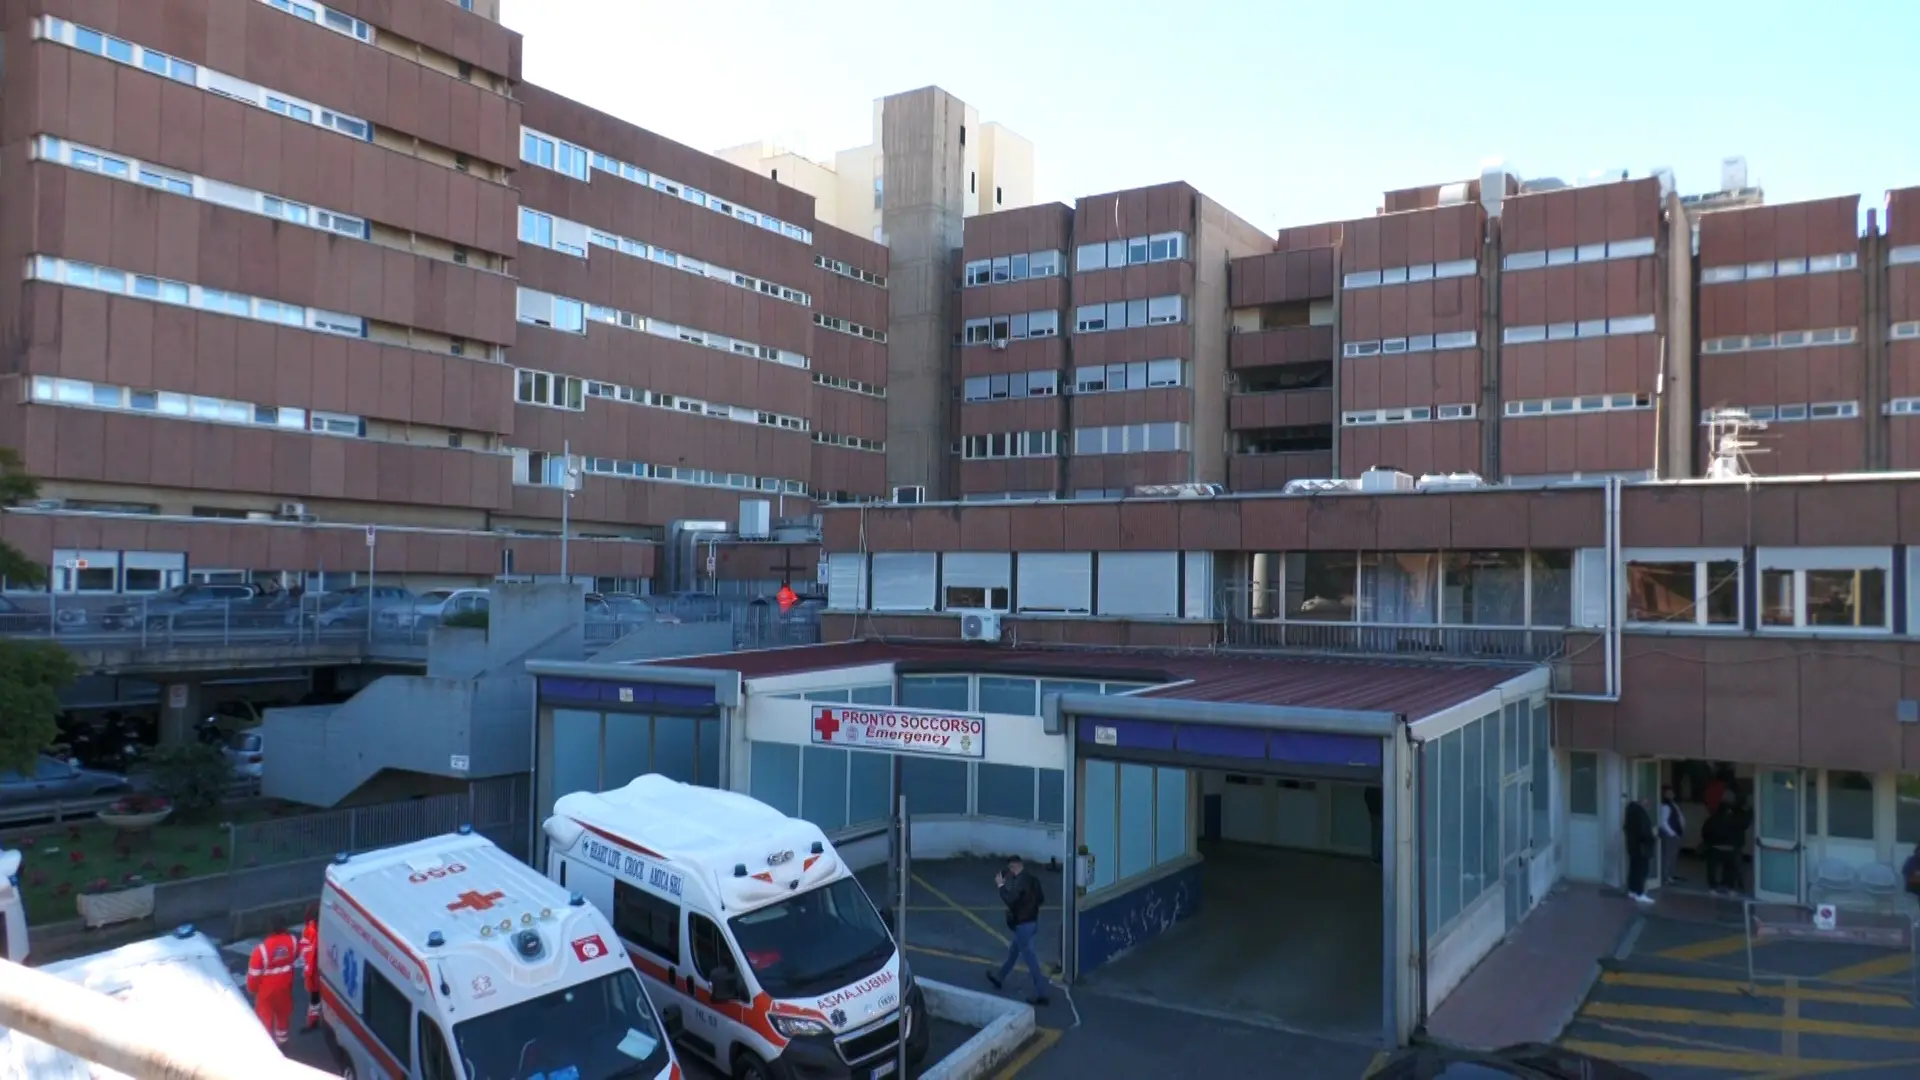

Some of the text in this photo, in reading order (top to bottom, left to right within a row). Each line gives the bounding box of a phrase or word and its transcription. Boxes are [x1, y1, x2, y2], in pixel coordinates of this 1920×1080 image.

[841, 710, 981, 734] PRONTO SOCCORSO
[865, 725, 950, 746] Emergency
[624, 855, 645, 880] CROCE
[648, 866, 669, 891] AMICA
[669, 873, 682, 896] SRL
